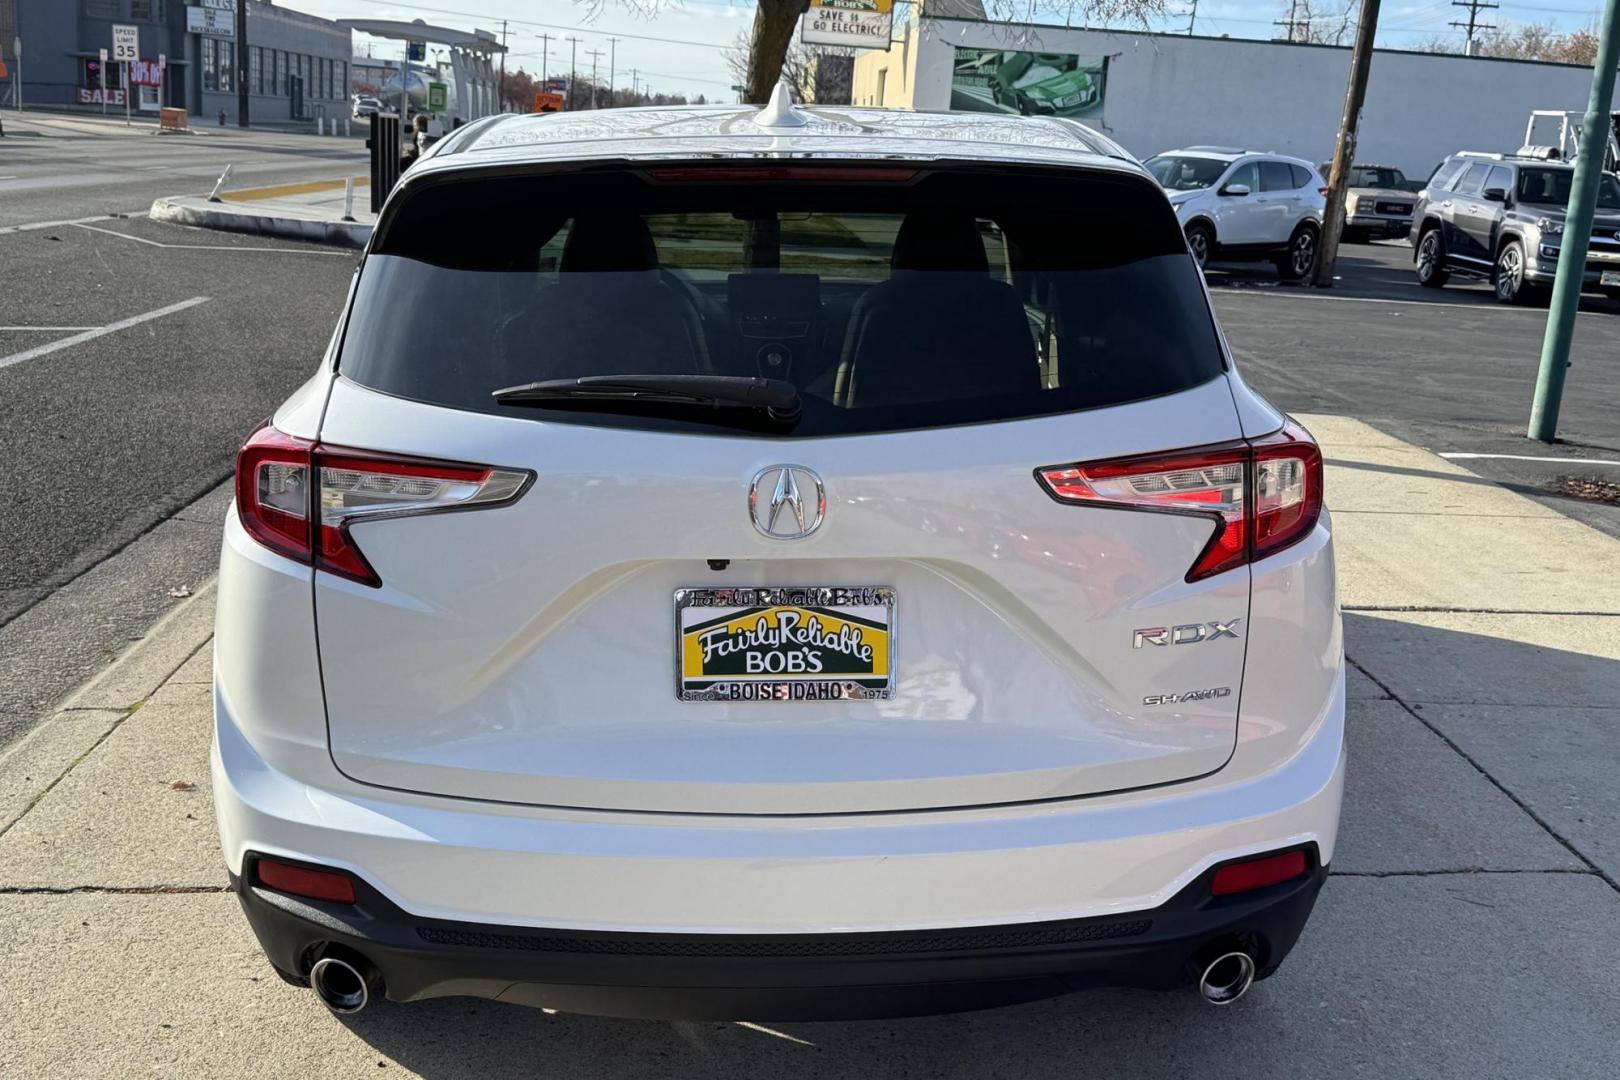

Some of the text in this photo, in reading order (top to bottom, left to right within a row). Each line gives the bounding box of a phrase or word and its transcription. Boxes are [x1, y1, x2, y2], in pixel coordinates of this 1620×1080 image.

[819, 10, 844, 21] SAVE
[115, 28, 136, 36] SPEED
[813, 21, 881, 36] GO ELECTRIC!
[116, 36, 134, 44] LIMIT
[116, 45, 136, 58] 35
[80, 88, 126, 104] SALE
[699, 610, 873, 664] Fairly Reliable
[1132, 617, 1243, 649] RDX
[745, 646, 823, 674] BOB'S
[683, 691, 715, 701] Since
[730, 682, 842, 700] BOISE IDAHO
[863, 690, 889, 700] 1975
